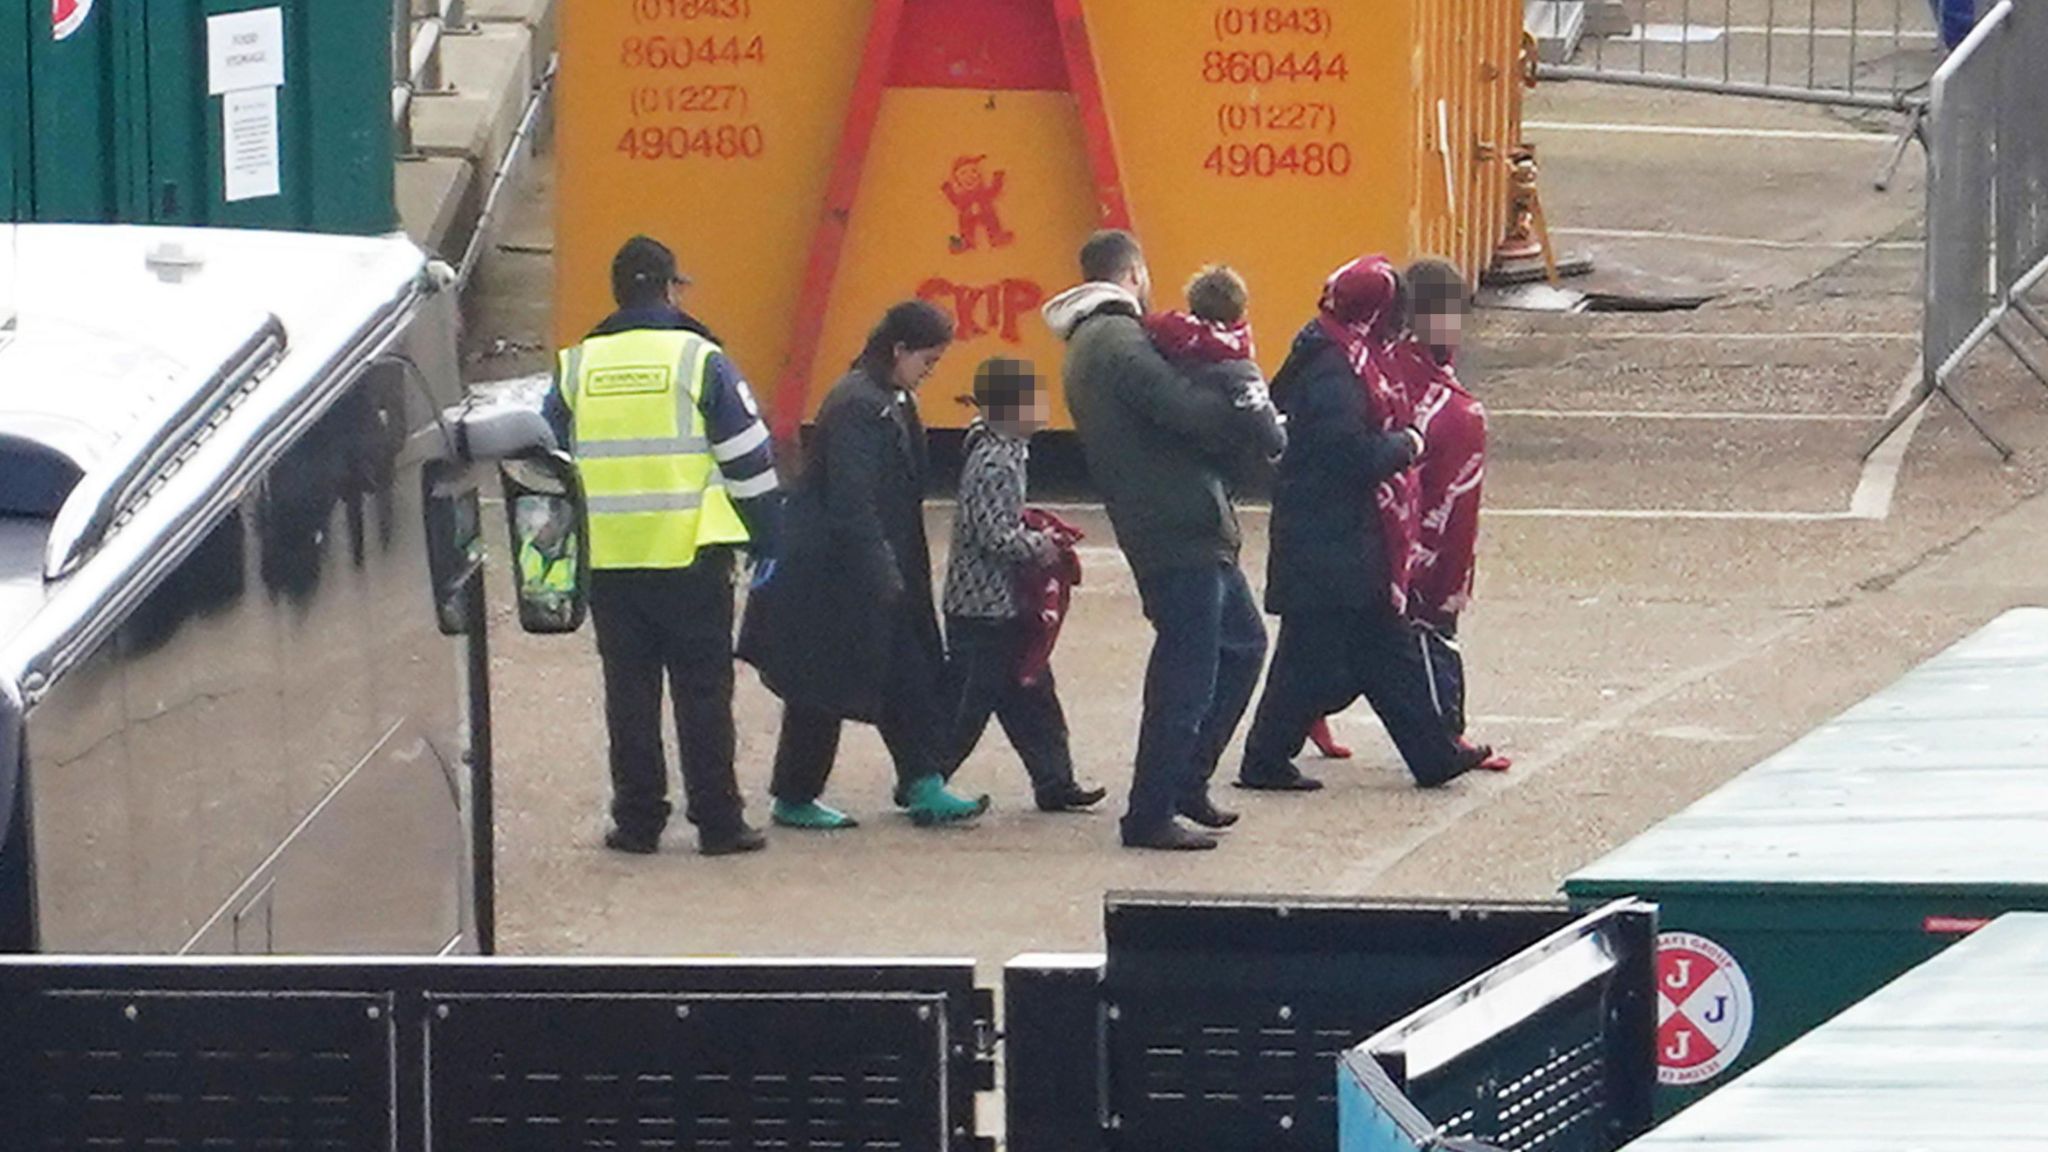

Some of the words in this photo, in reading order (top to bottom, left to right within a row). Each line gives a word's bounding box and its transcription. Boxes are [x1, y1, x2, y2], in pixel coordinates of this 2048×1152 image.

[632, 0, 750, 25] (01843)
[1214, 7, 1332, 42] (01843)
[620, 34, 764, 70] 860444
[1202, 50, 1349, 84] 860444
[629, 84, 748, 118] (01227)
[1218, 102, 1336, 137] (01227)
[616, 124, 765, 161] 490480
[1203, 142, 1352, 177] 490480
[1665, 958, 1693, 989] J
[1704, 995, 1728, 1024] J
[1664, 1030, 1692, 1060] J
